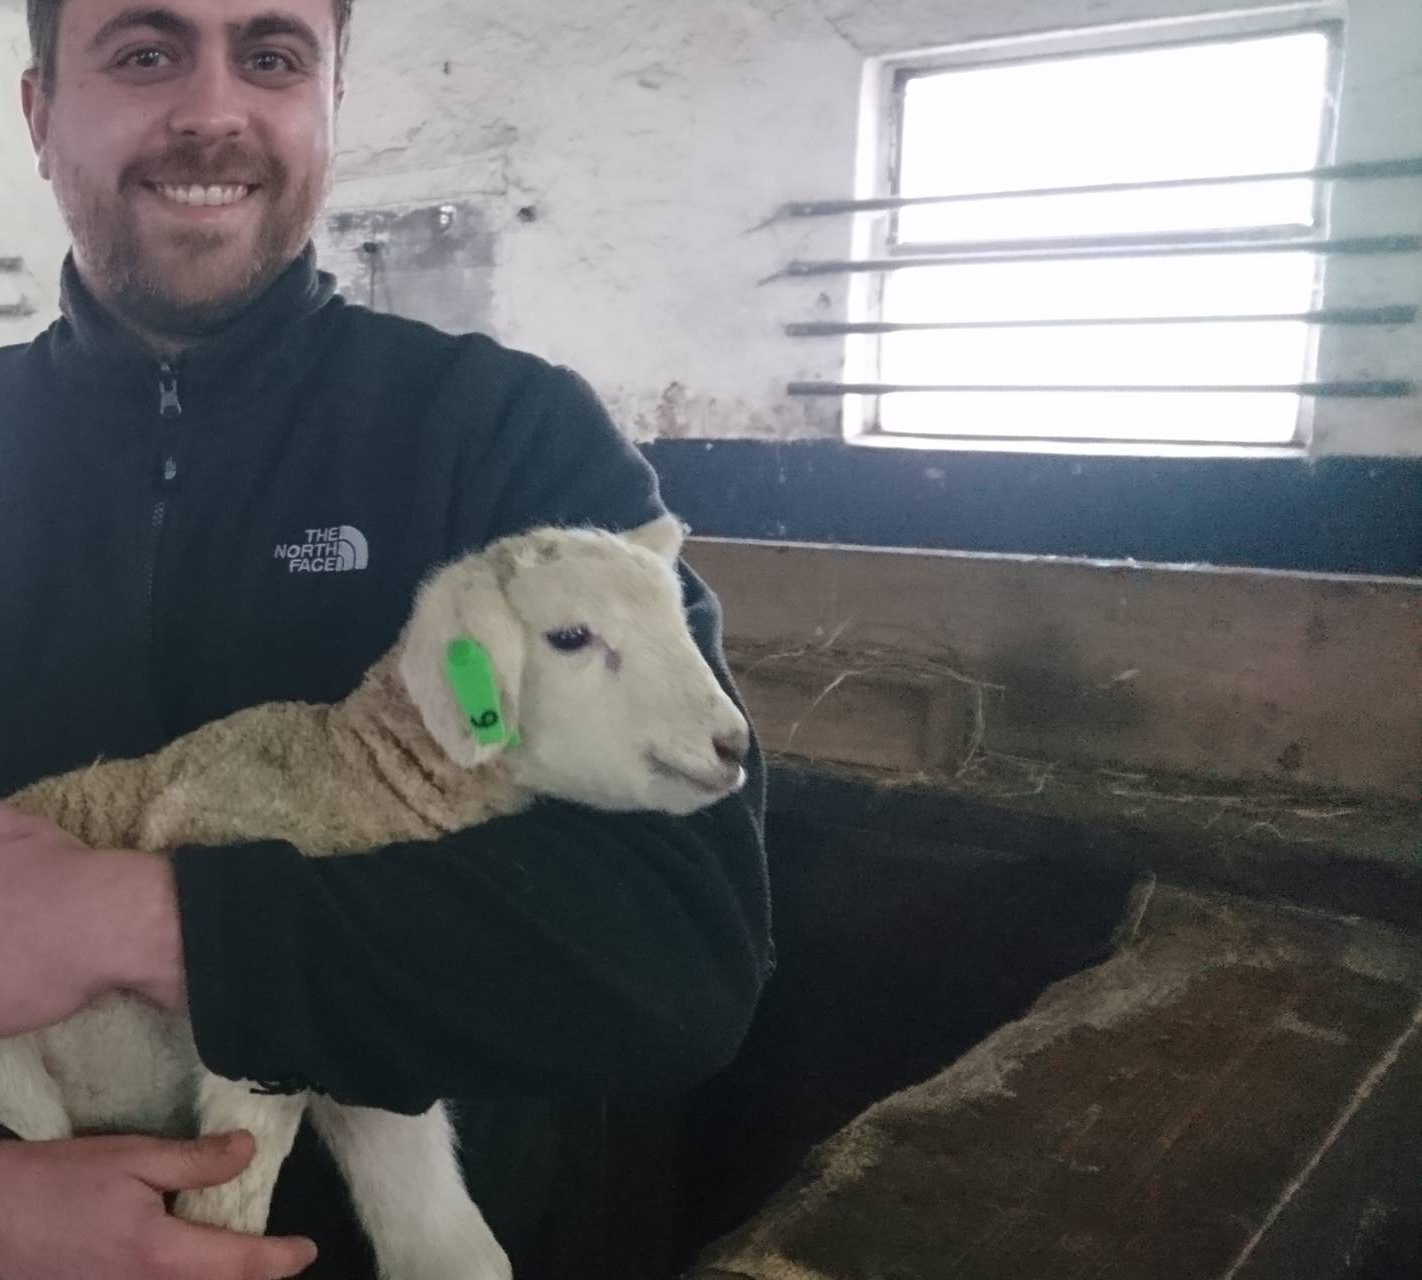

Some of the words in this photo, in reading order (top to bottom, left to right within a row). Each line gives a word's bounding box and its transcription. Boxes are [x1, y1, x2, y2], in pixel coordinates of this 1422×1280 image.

[305, 527, 339, 543] THE
[274, 541, 338, 559] NORTH
[290, 556, 336, 572] FACE
